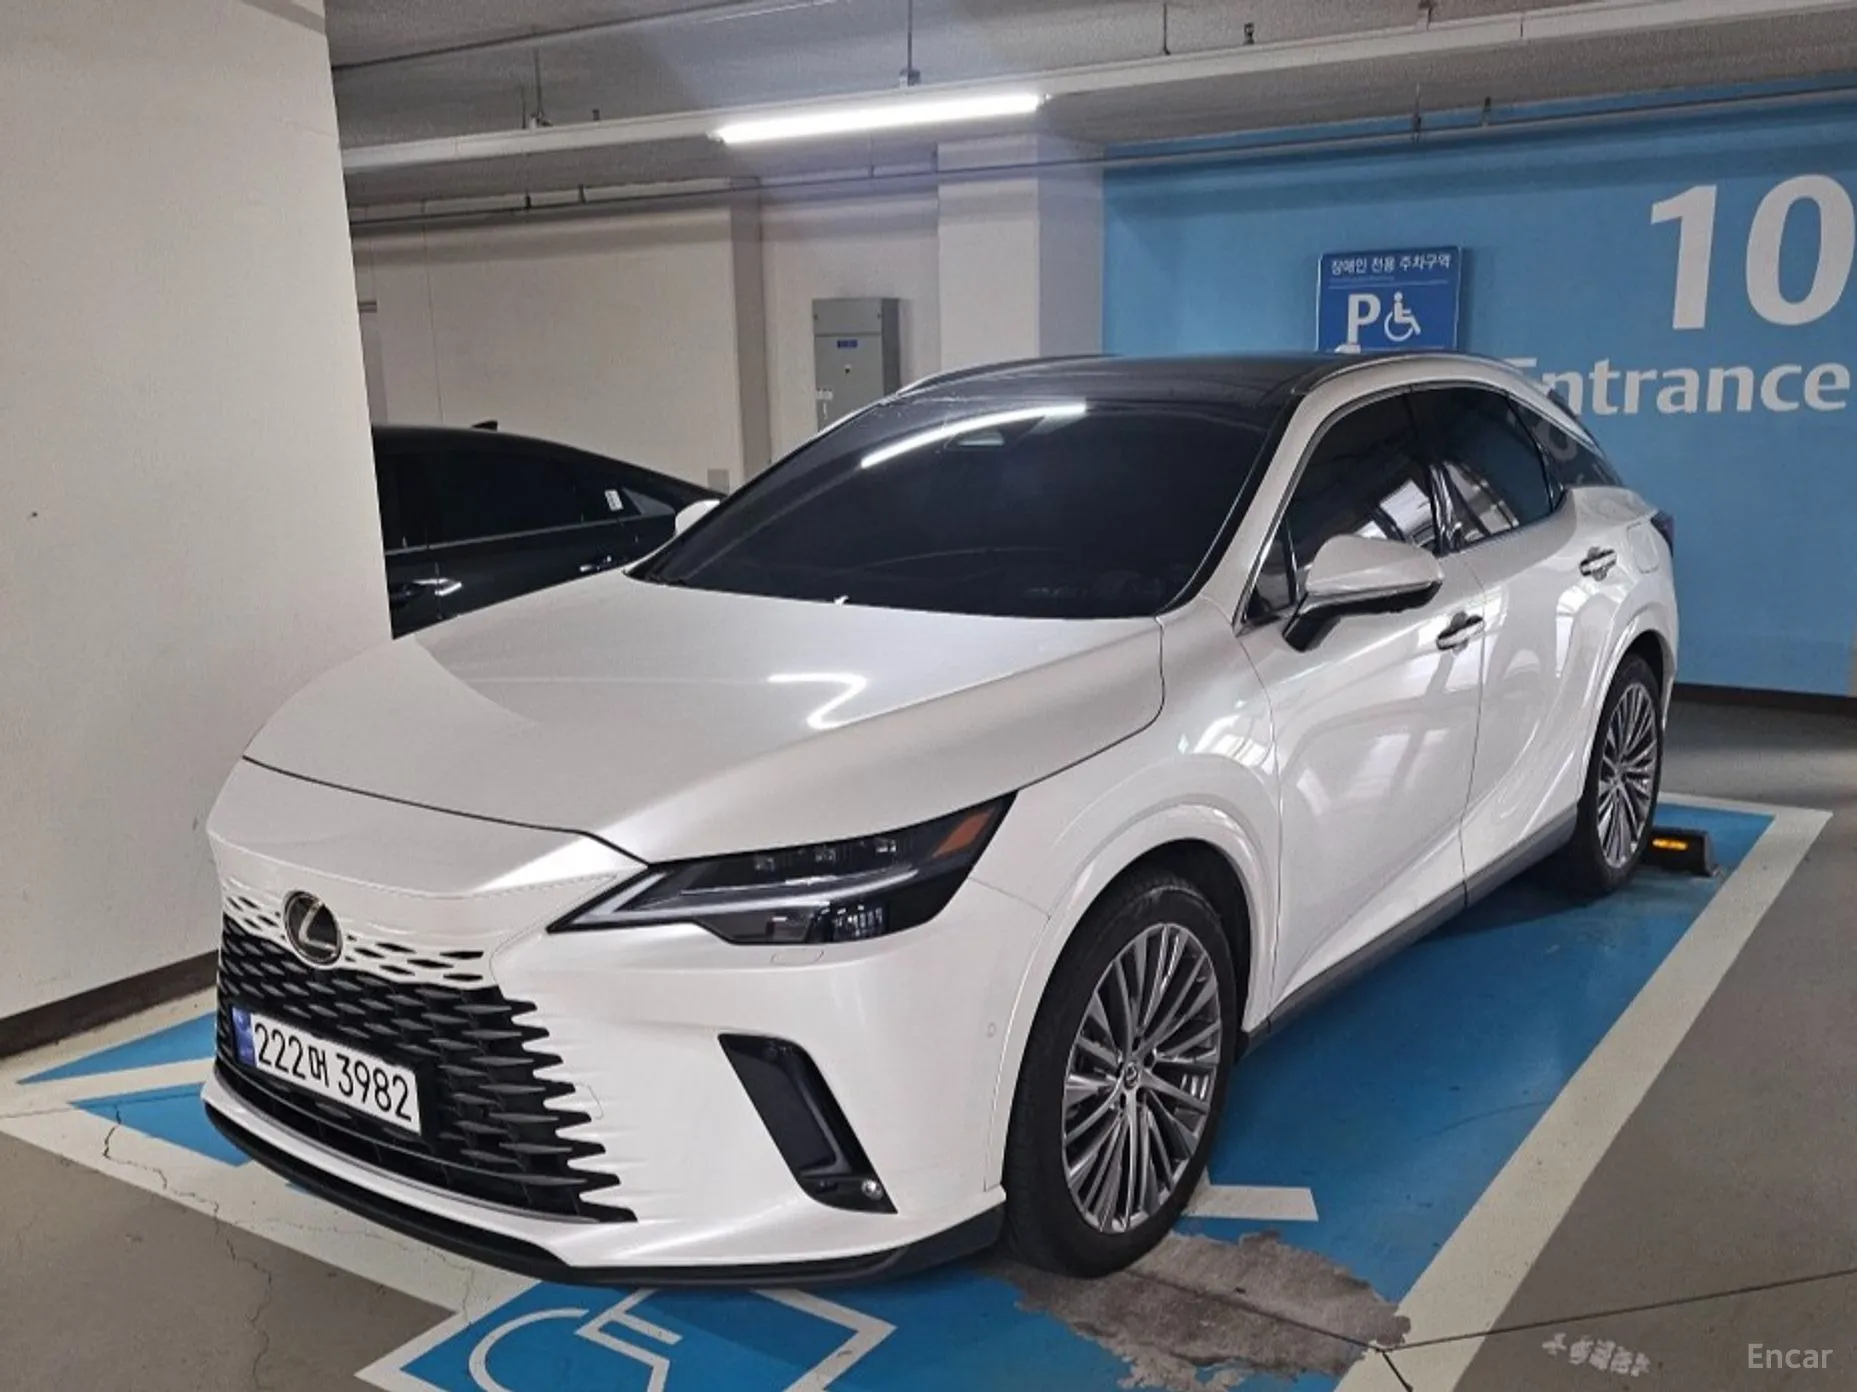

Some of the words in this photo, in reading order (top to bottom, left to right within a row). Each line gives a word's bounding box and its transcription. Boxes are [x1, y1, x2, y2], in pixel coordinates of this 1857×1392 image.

[1331, 257, 1367, 276] 장애인
[1372, 255, 1395, 274] 전용
[1650, 174, 1856, 330] 10
[1347, 293, 1382, 345] P
[336, 1053, 412, 1123] 3982
